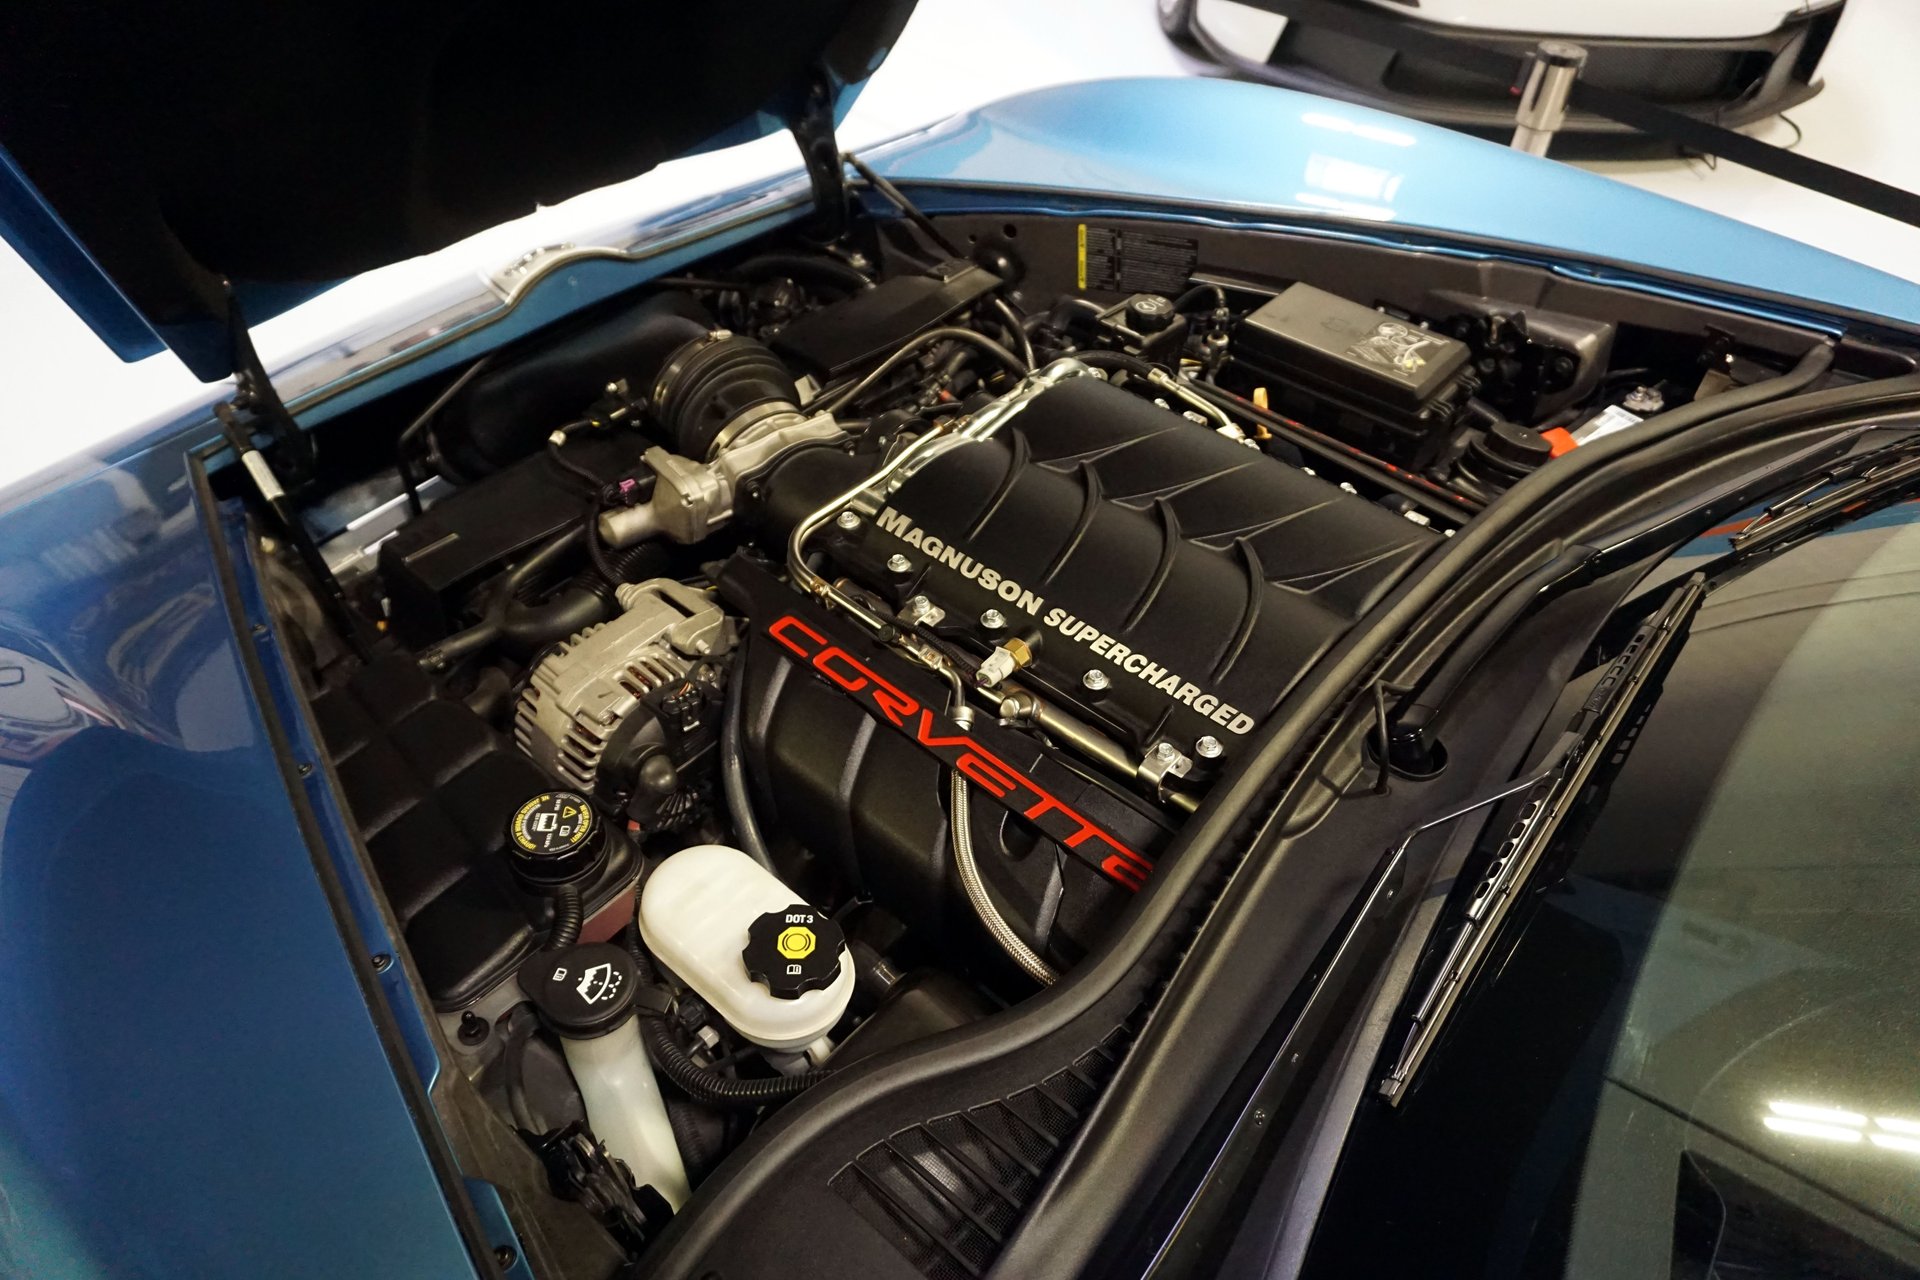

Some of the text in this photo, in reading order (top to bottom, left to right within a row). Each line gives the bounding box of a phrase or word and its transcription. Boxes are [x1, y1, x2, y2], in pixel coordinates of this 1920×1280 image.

[876, 507, 1257, 737] MAGNUSON SUPERCHARGED
[769, 615, 1153, 893] CORVETTE
[785, 914, 814, 924] DOT 3
